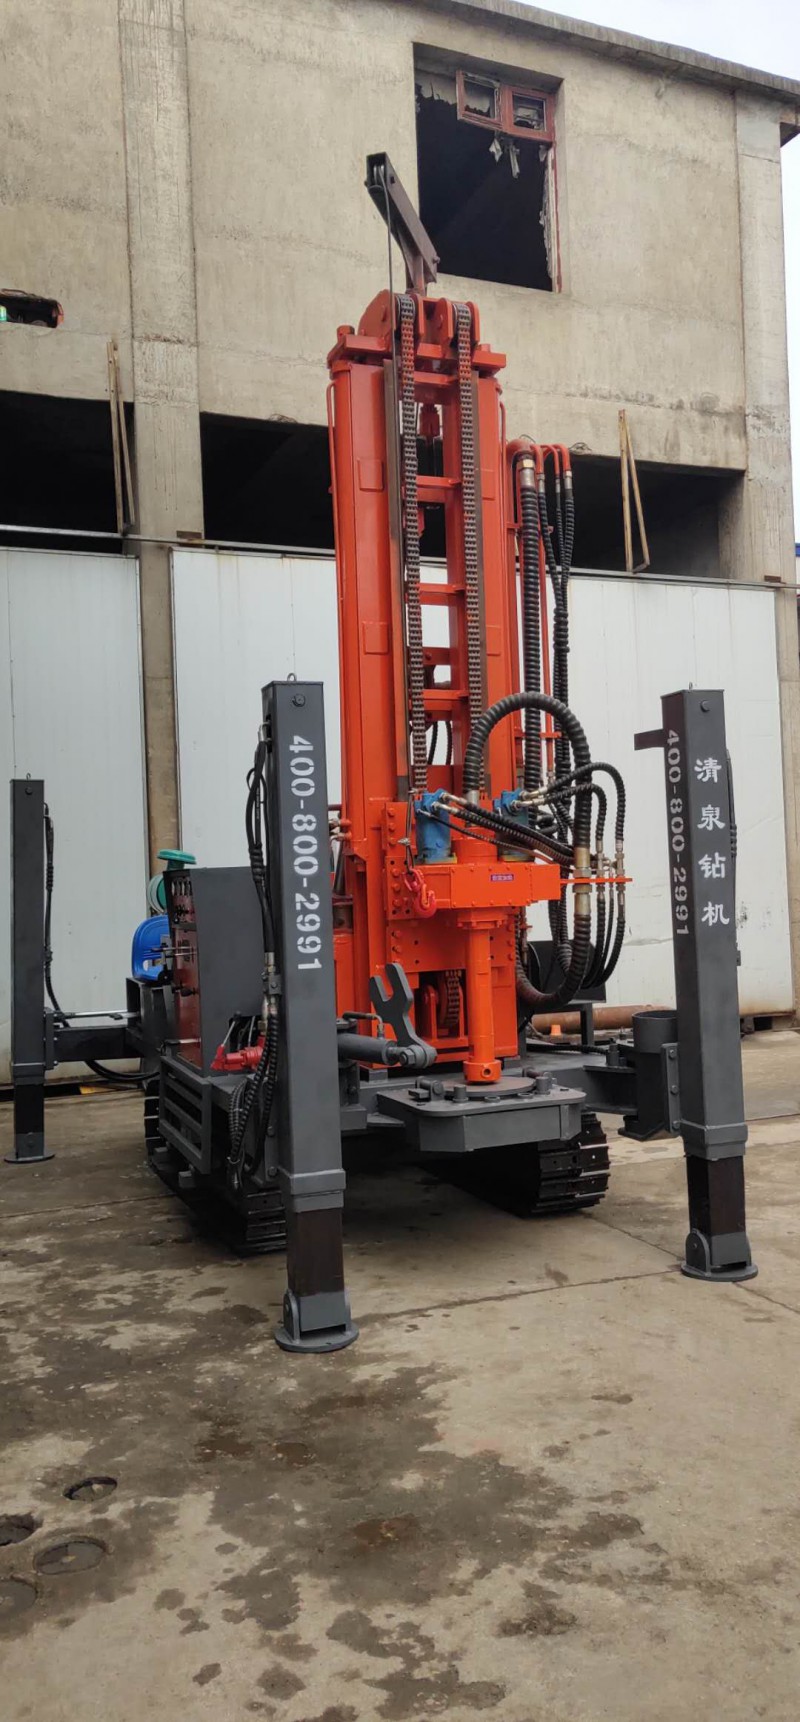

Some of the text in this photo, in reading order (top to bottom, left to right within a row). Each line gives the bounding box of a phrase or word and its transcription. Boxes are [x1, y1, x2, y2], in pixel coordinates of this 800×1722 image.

[289, 735, 322, 969] 400-800-2991
[667, 730, 689, 935] 400-800-2991
[694, 758, 730, 926] 清泉钻机
